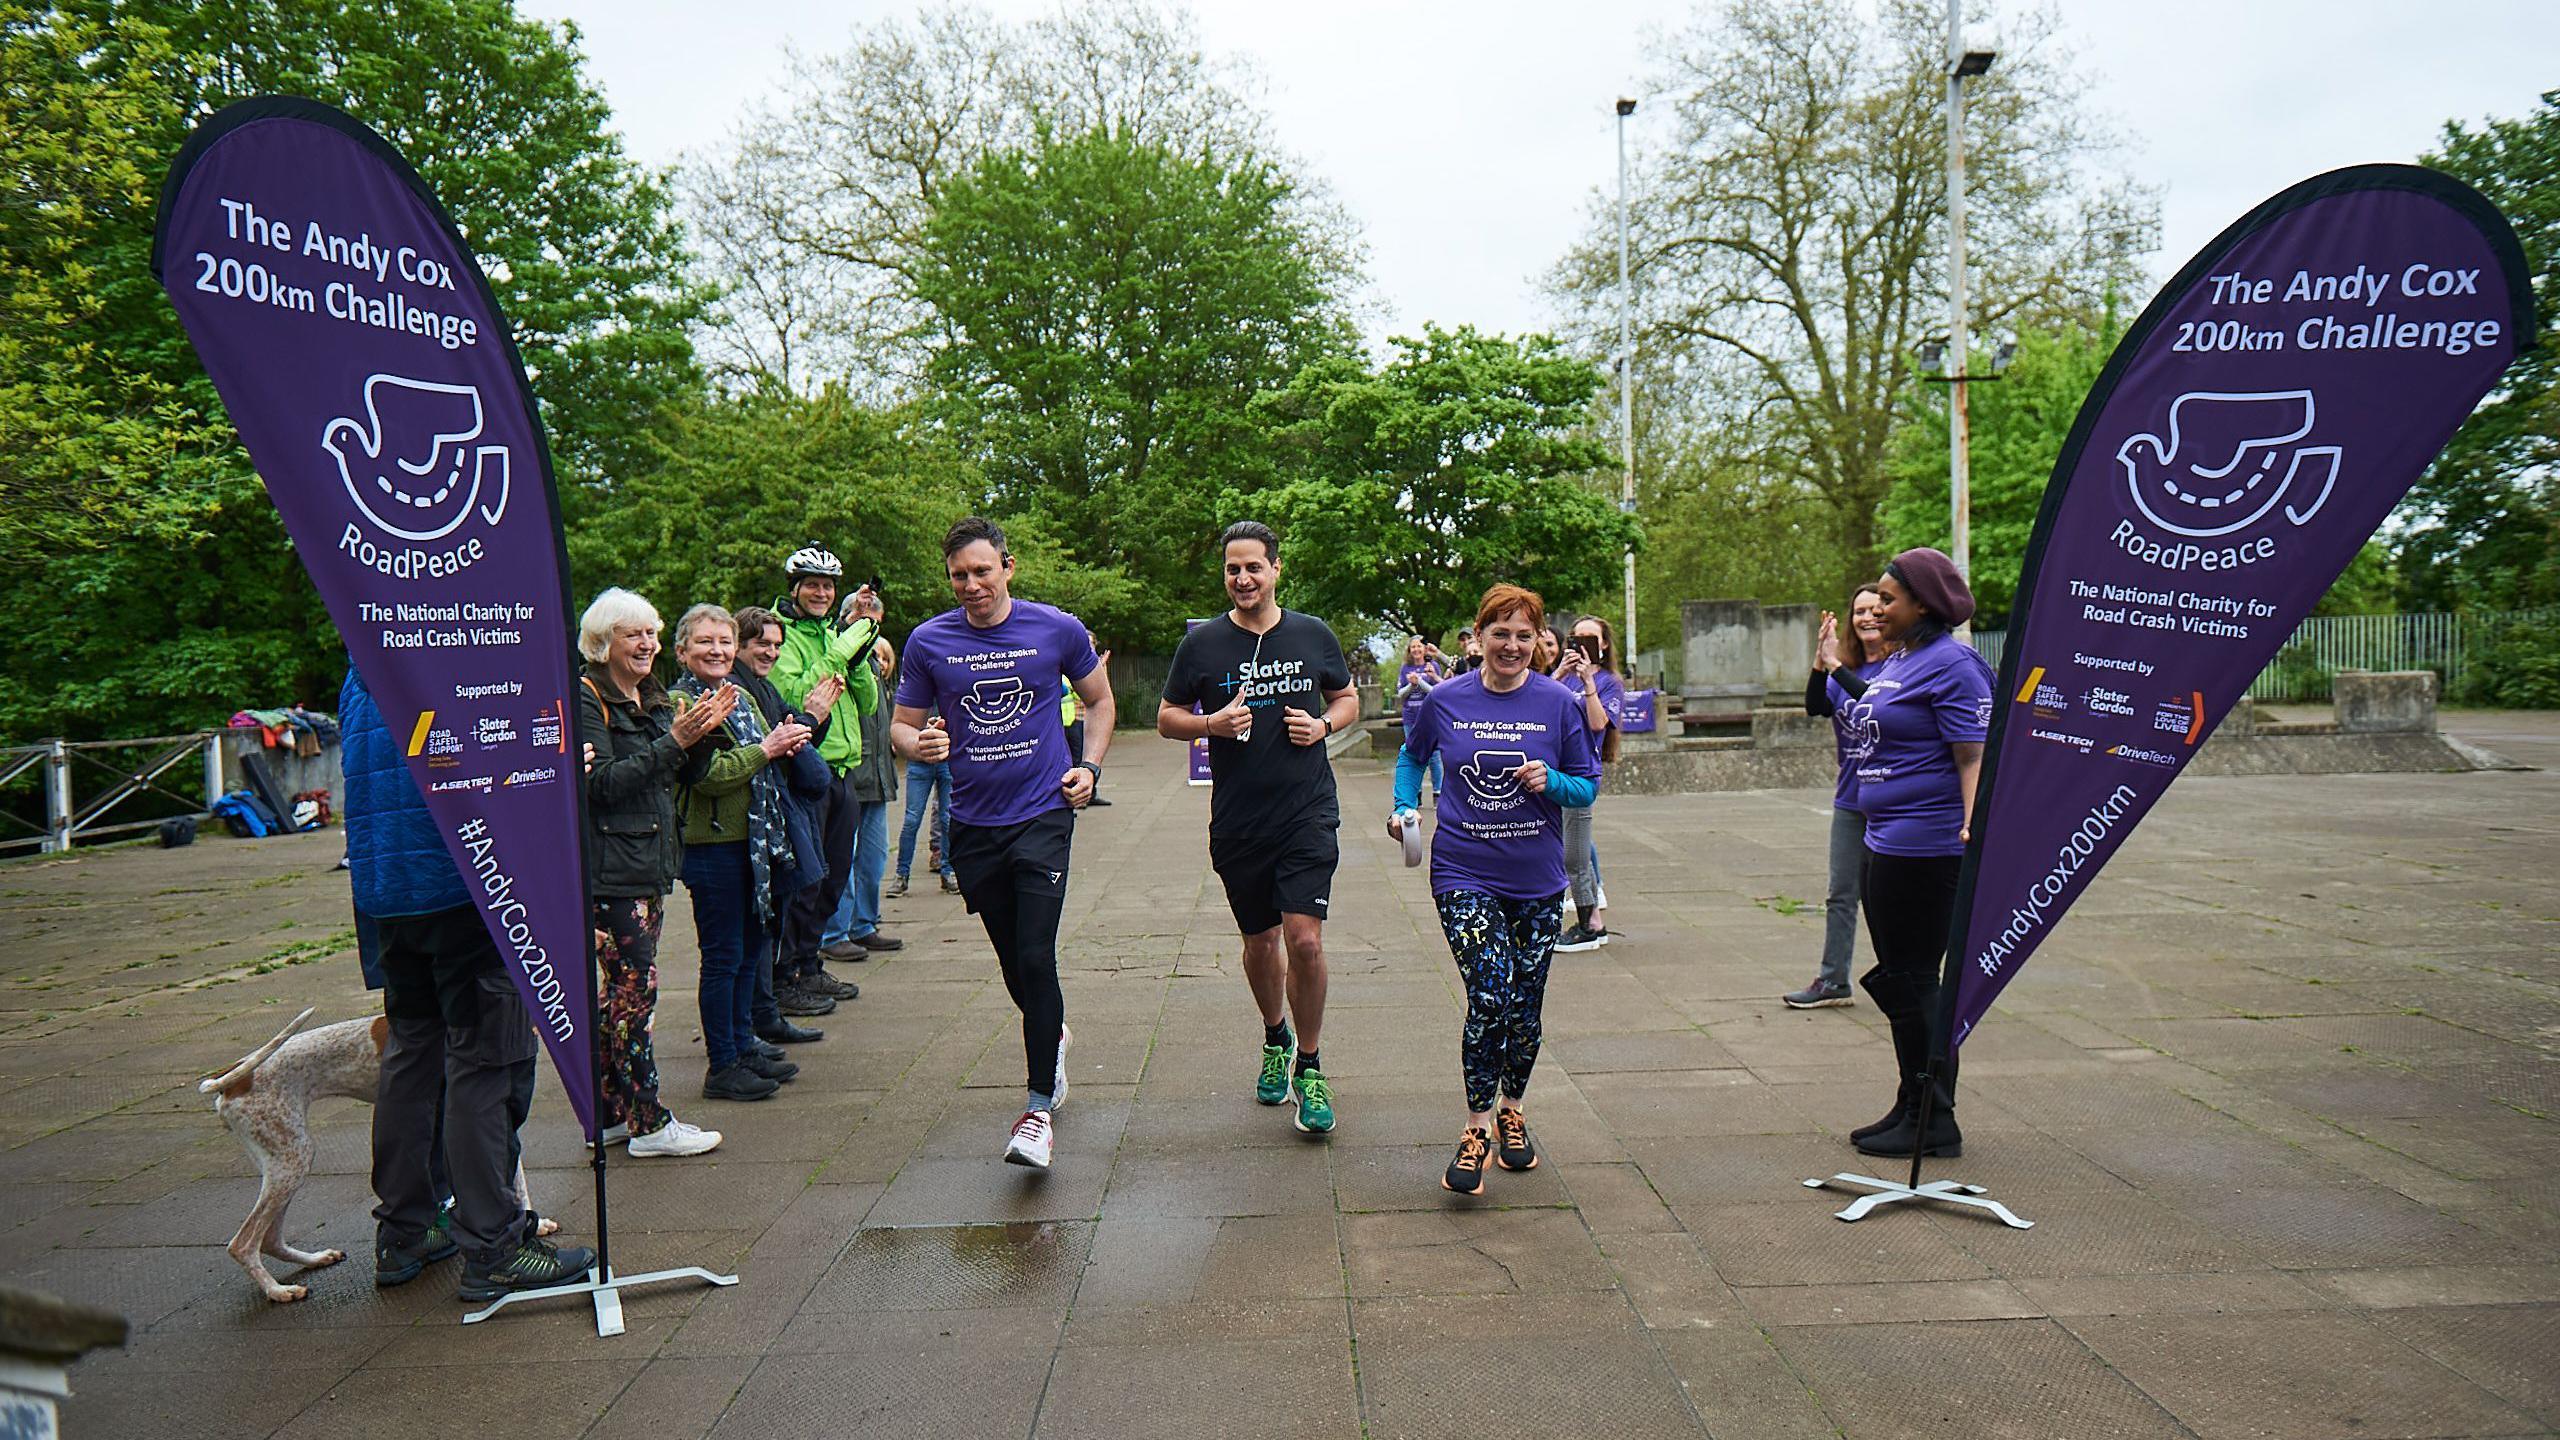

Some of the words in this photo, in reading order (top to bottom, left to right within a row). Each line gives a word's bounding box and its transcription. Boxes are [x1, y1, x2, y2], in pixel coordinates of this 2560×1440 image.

[220, 198, 291, 251] The
[303, 222, 390, 283] Andy
[397, 247, 456, 291] Cox
[2209, 271, 2273, 305] The
[2283, 265, 2390, 307] Andy
[2400, 263, 2480, 297] Cox
[195, 252, 315, 313] 200km
[325, 282, 477, 349] Challenge
[2172, 320, 2285, 352] 200km
[2296, 314, 2500, 356] Challenge
[338, 522, 484, 579] RoadPeace
[2110, 518, 2276, 571] RoadPeace
[2069, 581, 2099, 598] The
[2102, 584, 2174, 607] National
[2178, 592, 2243, 618] Charity
[2248, 599, 2277, 618] for
[359, 603, 393, 622] The
[397, 602, 460, 621] National
[463, 603, 512, 624] Charity
[515, 602, 534, 620] for
[2083, 604, 2125, 624] Road
[2129, 610, 2176, 630] Crash
[2181, 616, 2248, 639] Victims
[382, 628, 423, 648] Road
[426, 629, 467, 647] Crash
[469, 628, 521, 646] Victims
[946, 656, 963, 665] The
[965, 653, 988, 663] Andy
[989, 651, 1006, 660] Cox
[1007, 648, 1038, 658] 200km
[2074, 652, 2136, 672] Supported
[2138, 661, 2155, 677] by
[970, 660, 1015, 671] Challenge
[1239, 659, 1304, 681] Slater
[455, 681, 508, 699] Supported
[510, 681, 523, 696] by
[1240, 675, 1313, 698] Gordon
[2037, 684, 2057, 693] ROAD
[2092, 687, 2130, 703] Slater
[2034, 698, 2068, 710] SUPPORT
[2035, 691, 2064, 701] SAFETY
[2090, 699, 2134, 716] Gordon
[479, 718, 511, 731] Slater
[968, 718, 1021, 735] RoadPeace
[1452, 721, 1469, 730] The
[1470, 721, 1495, 731] Andy
[1496, 722, 1514, 730] Cox
[1515, 722, 1547, 732] 200km
[2154, 721, 2188, 734] LIVES
[429, 737, 458, 746] SAFETY
[430, 729, 451, 738] ROAD
[480, 730, 517, 743] Gordon
[532, 737, 560, 746] LIVES
[1474, 730, 1522, 742] Challenge
[2032, 729, 2066, 743] LASER
[2067, 735, 2094, 747] TECH
[429, 744, 463, 755] SUPPORT
[974, 745, 1003, 753] National
[1004, 741, 1029, 751] Charity
[2118, 744, 2176, 765] DriveTech
[970, 754, 986, 762] Road
[987, 752, 1007, 761] Crash
[431, 780, 471, 791] LASER
[471, 777, 493, 787] TECH
[512, 767, 556, 784] DriveTech
[1467, 794, 1526, 811] RoadPeace
[1475, 822, 1508, 830] National
[1509, 821, 1536, 829] Charity
[1490, 830, 1512, 839] Crash
[1512, 829, 1540, 837] Victims
[1978, 784, 2137, 977] #AndyCox200km
[457, 818, 574, 1043] #AndyCox200km
